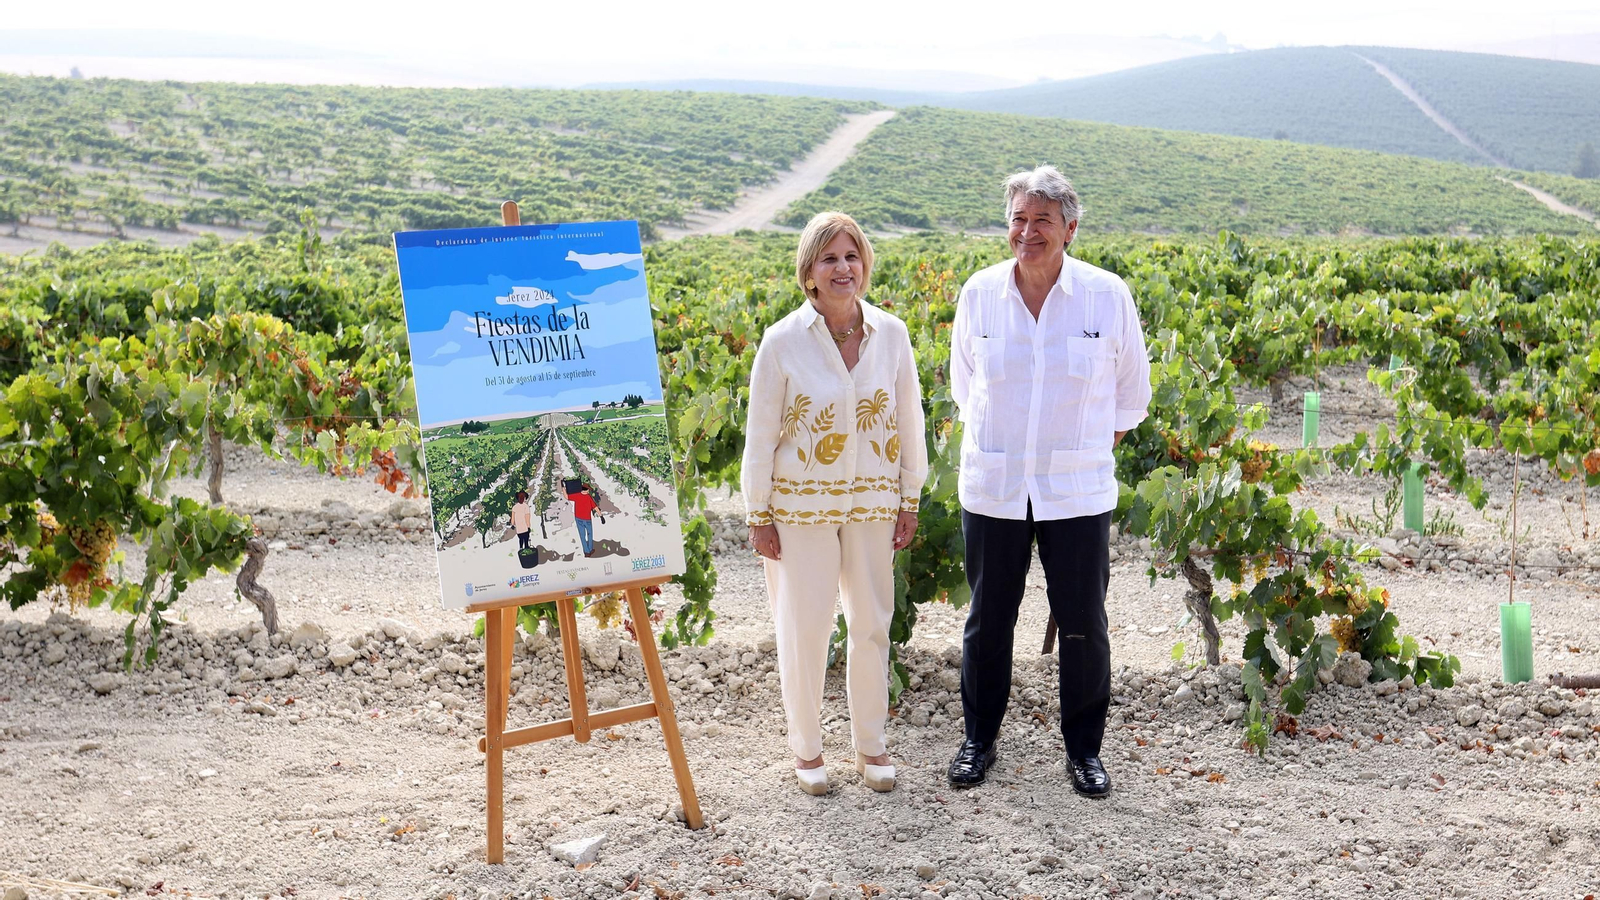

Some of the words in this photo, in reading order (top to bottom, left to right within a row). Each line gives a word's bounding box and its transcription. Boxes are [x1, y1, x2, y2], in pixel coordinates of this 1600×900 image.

[506, 291, 531, 303] Jerez
[533, 289, 555, 301] 2024
[474, 311, 541, 338] Fiestas
[548, 305, 569, 332] de
[572, 303, 590, 330] la
[488, 333, 586, 367] VENDIMIA
[485, 376, 497, 387] Del
[506, 374, 515, 384] de
[516, 374, 537, 386] agosto
[538, 373, 545, 382] al
[546, 372, 552, 380] 15
[554, 370, 561, 380] de
[563, 369, 596, 381] septiembre
[631, 558, 650, 570] JEREZ
[651, 555, 666, 567] 2031
[520, 574, 540, 584] JEREZ
